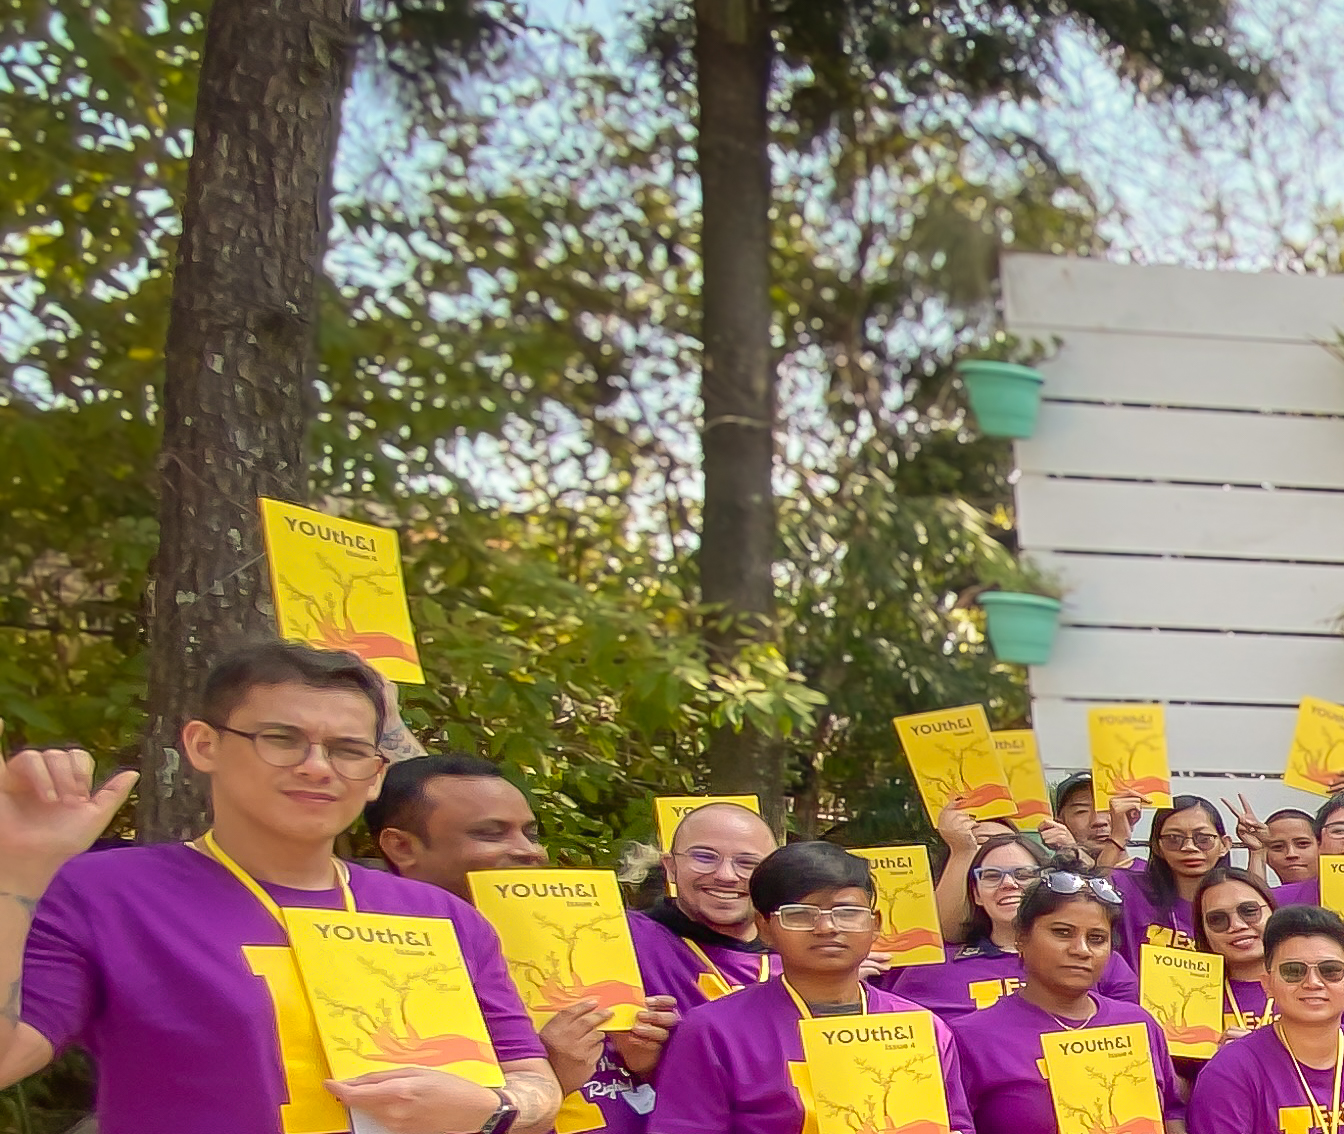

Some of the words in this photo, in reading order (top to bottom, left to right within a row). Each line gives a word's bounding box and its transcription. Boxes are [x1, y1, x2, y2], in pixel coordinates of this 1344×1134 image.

[283, 515, 377, 554] YOUth&I
[494, 882, 598, 900] YOUth&I
[313, 923, 432, 947] YOUth&I
[1154, 955, 1210, 972] YOUth&I
[822, 1025, 914, 1045] YOUth&I
[1059, 1036, 1132, 1056] YOUth&I
